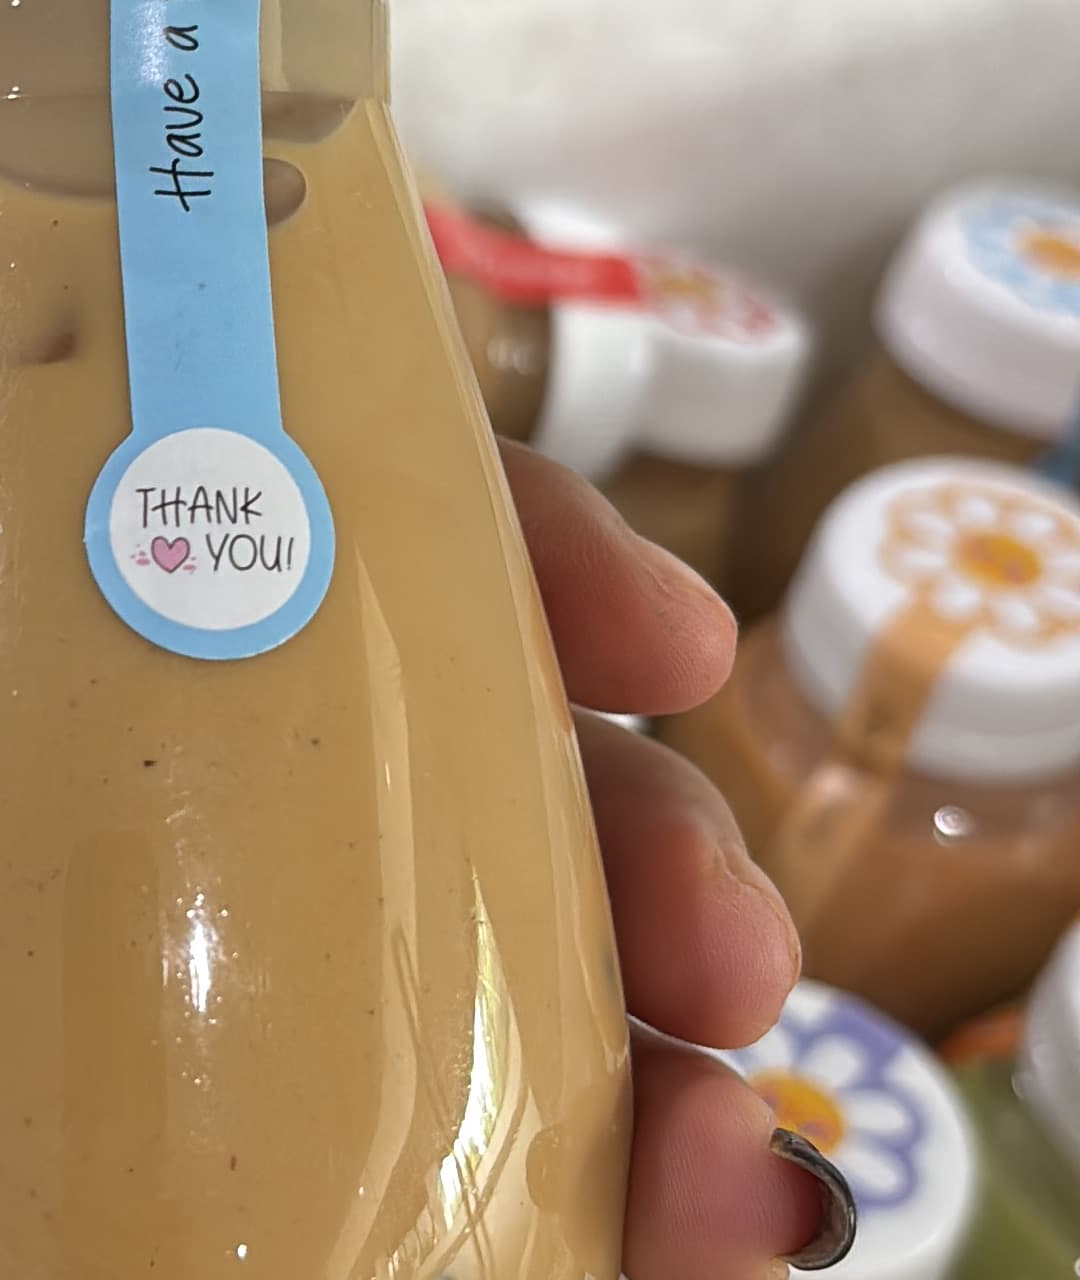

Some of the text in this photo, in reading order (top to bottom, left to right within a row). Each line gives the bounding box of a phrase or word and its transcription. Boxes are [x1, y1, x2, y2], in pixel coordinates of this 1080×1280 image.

[162, 24, 199, 52] a
[148, 73, 215, 212] Have
[135, 485, 263, 528] THANK
[205, 533, 295, 573] YOU!
